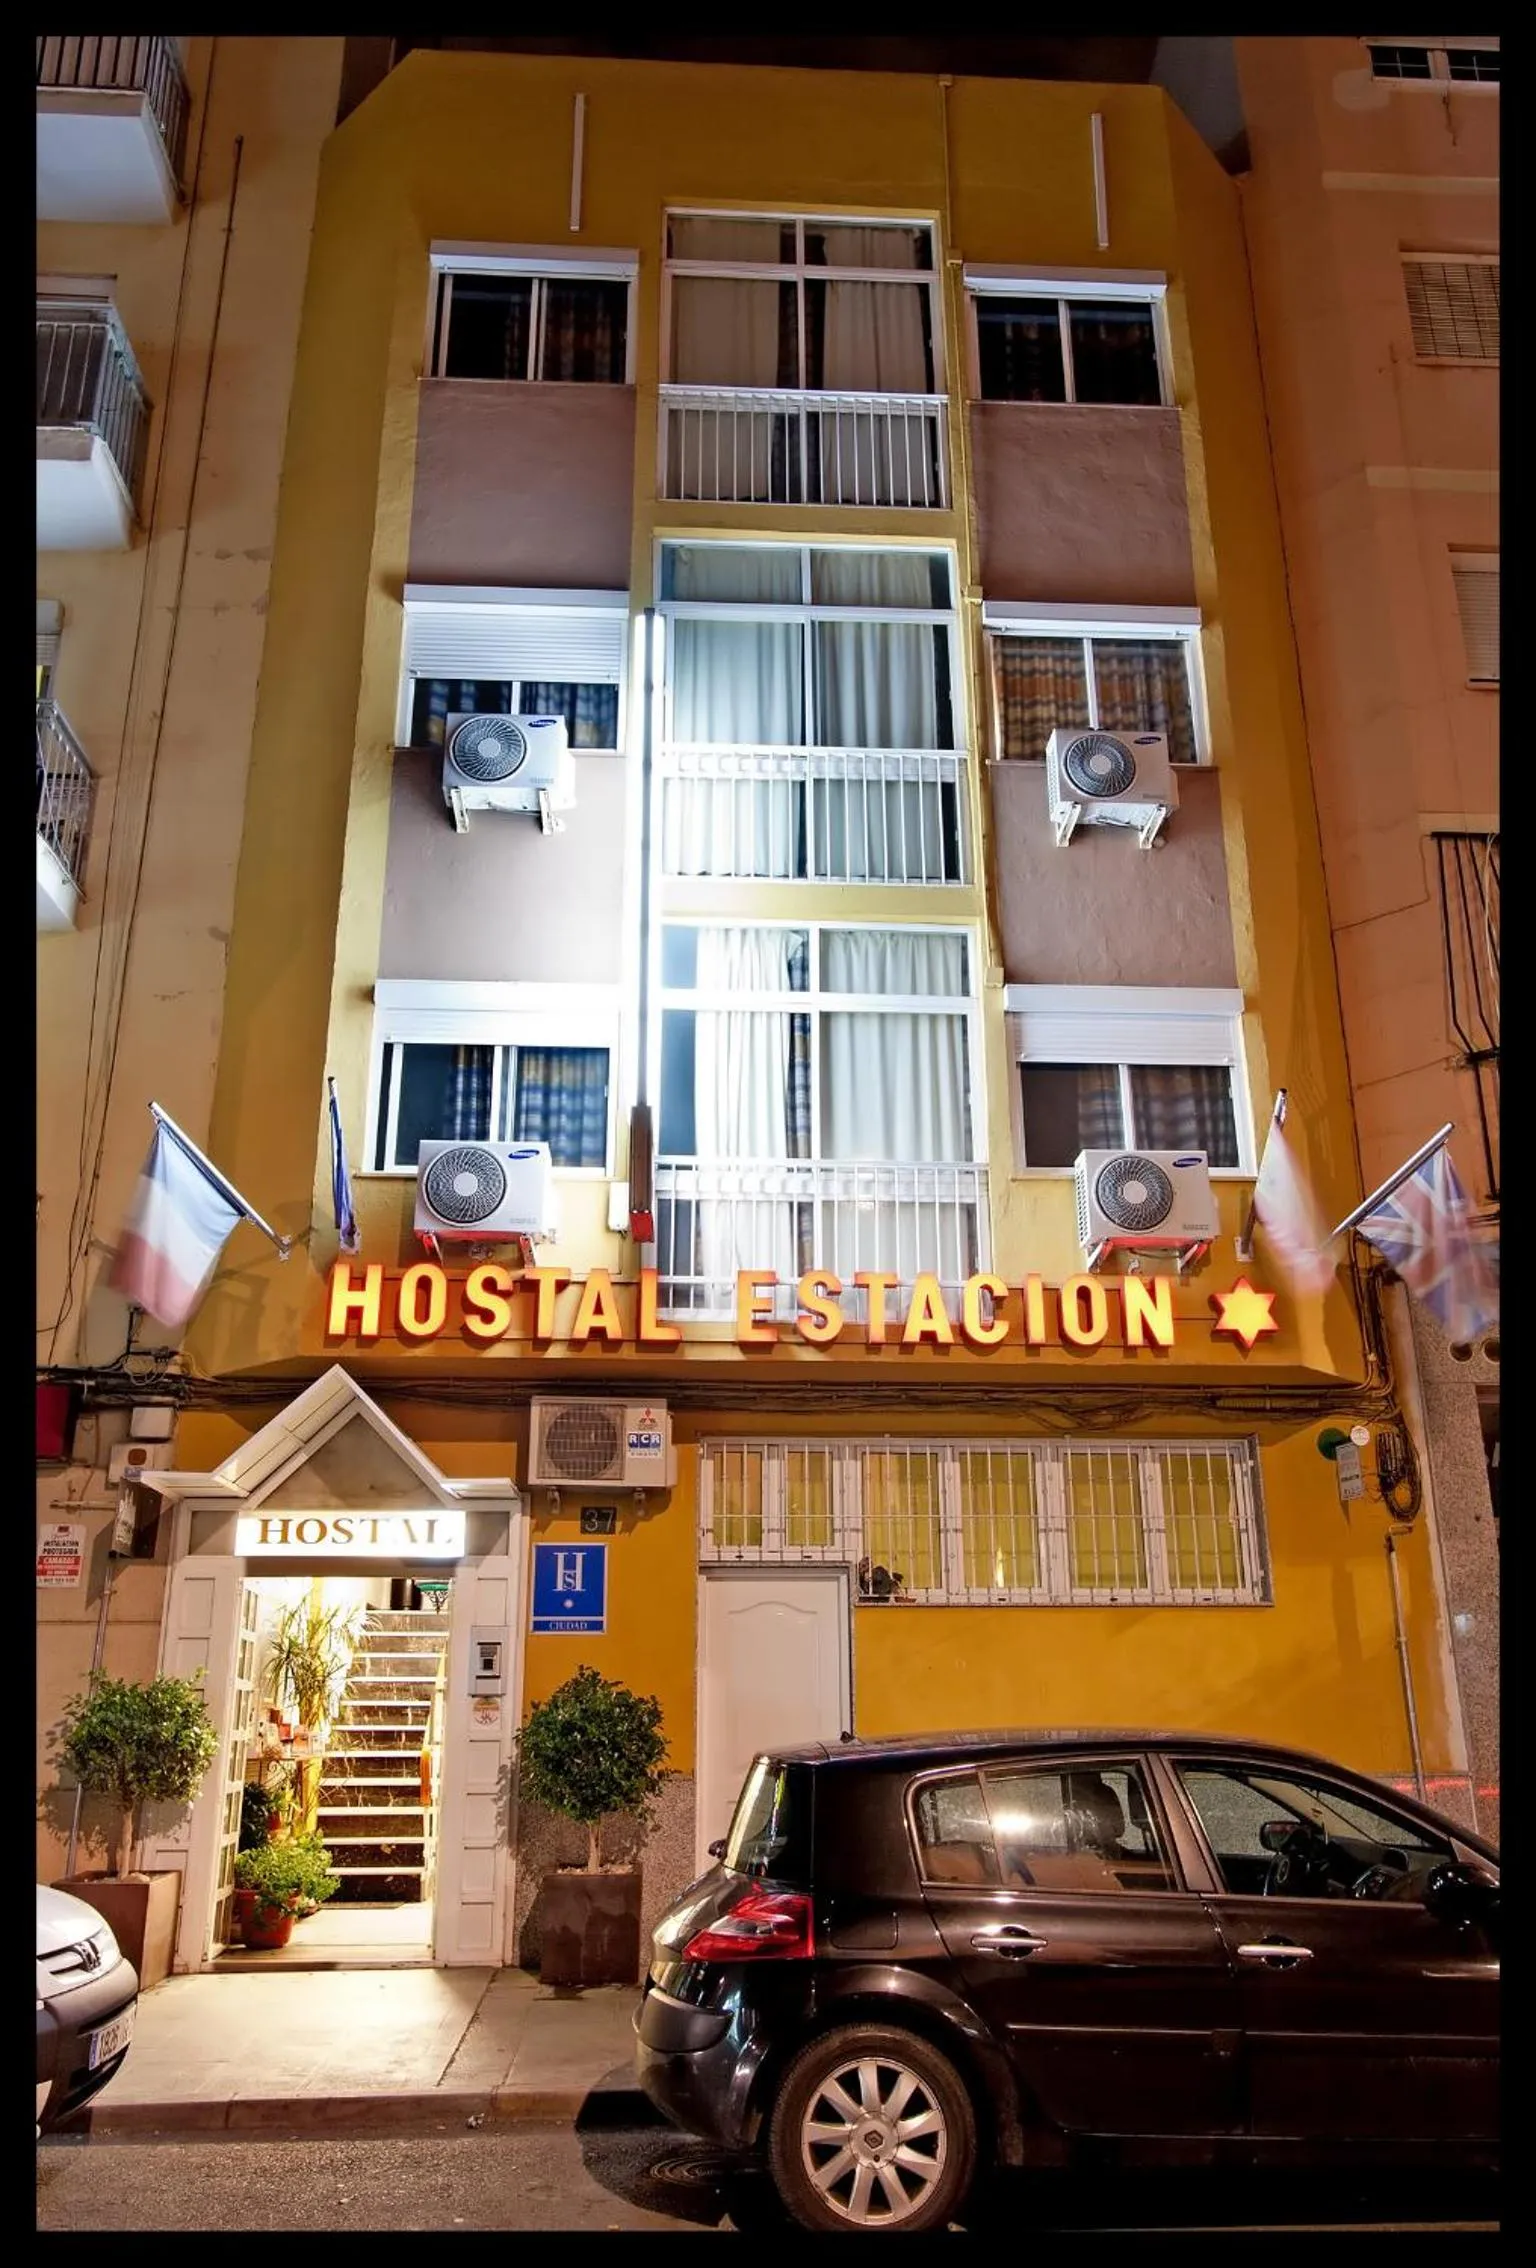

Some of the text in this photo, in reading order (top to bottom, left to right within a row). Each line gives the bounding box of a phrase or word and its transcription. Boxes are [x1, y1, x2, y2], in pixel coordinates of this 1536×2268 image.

[326, 1262, 1176, 1347] HOSTAL ESTACION
[628, 1433, 660, 1445] RCR
[584, 1509, 614, 1532] 37
[548, 1621, 588, 1630] CIUDAD
